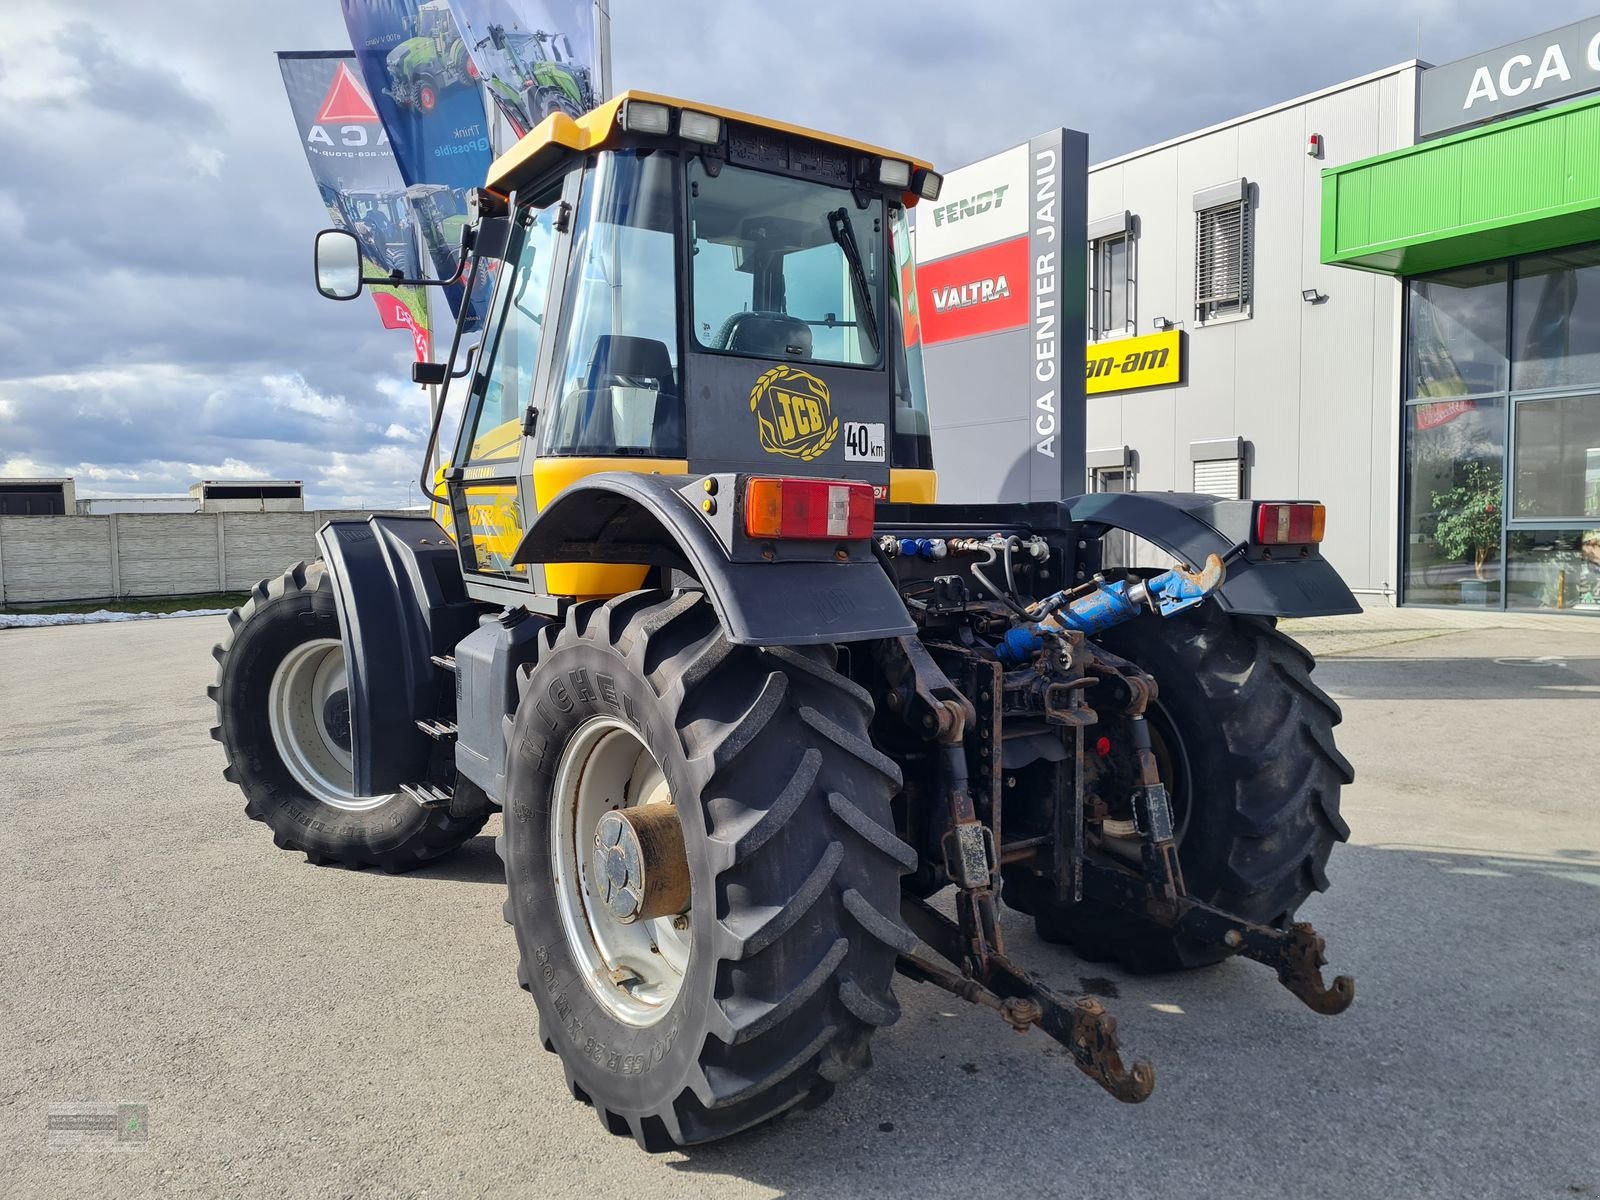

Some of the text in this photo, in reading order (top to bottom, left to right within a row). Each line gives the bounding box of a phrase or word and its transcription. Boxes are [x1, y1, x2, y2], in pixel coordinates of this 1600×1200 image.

[1463, 44, 1571, 110] ACA
[932, 184, 1010, 227] FENDT
[931, 274, 1011, 314] VALTRA
[1035, 149, 1056, 458] ACA CENTER JANU
[1086, 347, 1169, 379] an-am
[777, 391, 822, 442] JCB
[846, 424, 883, 457] 40 km
